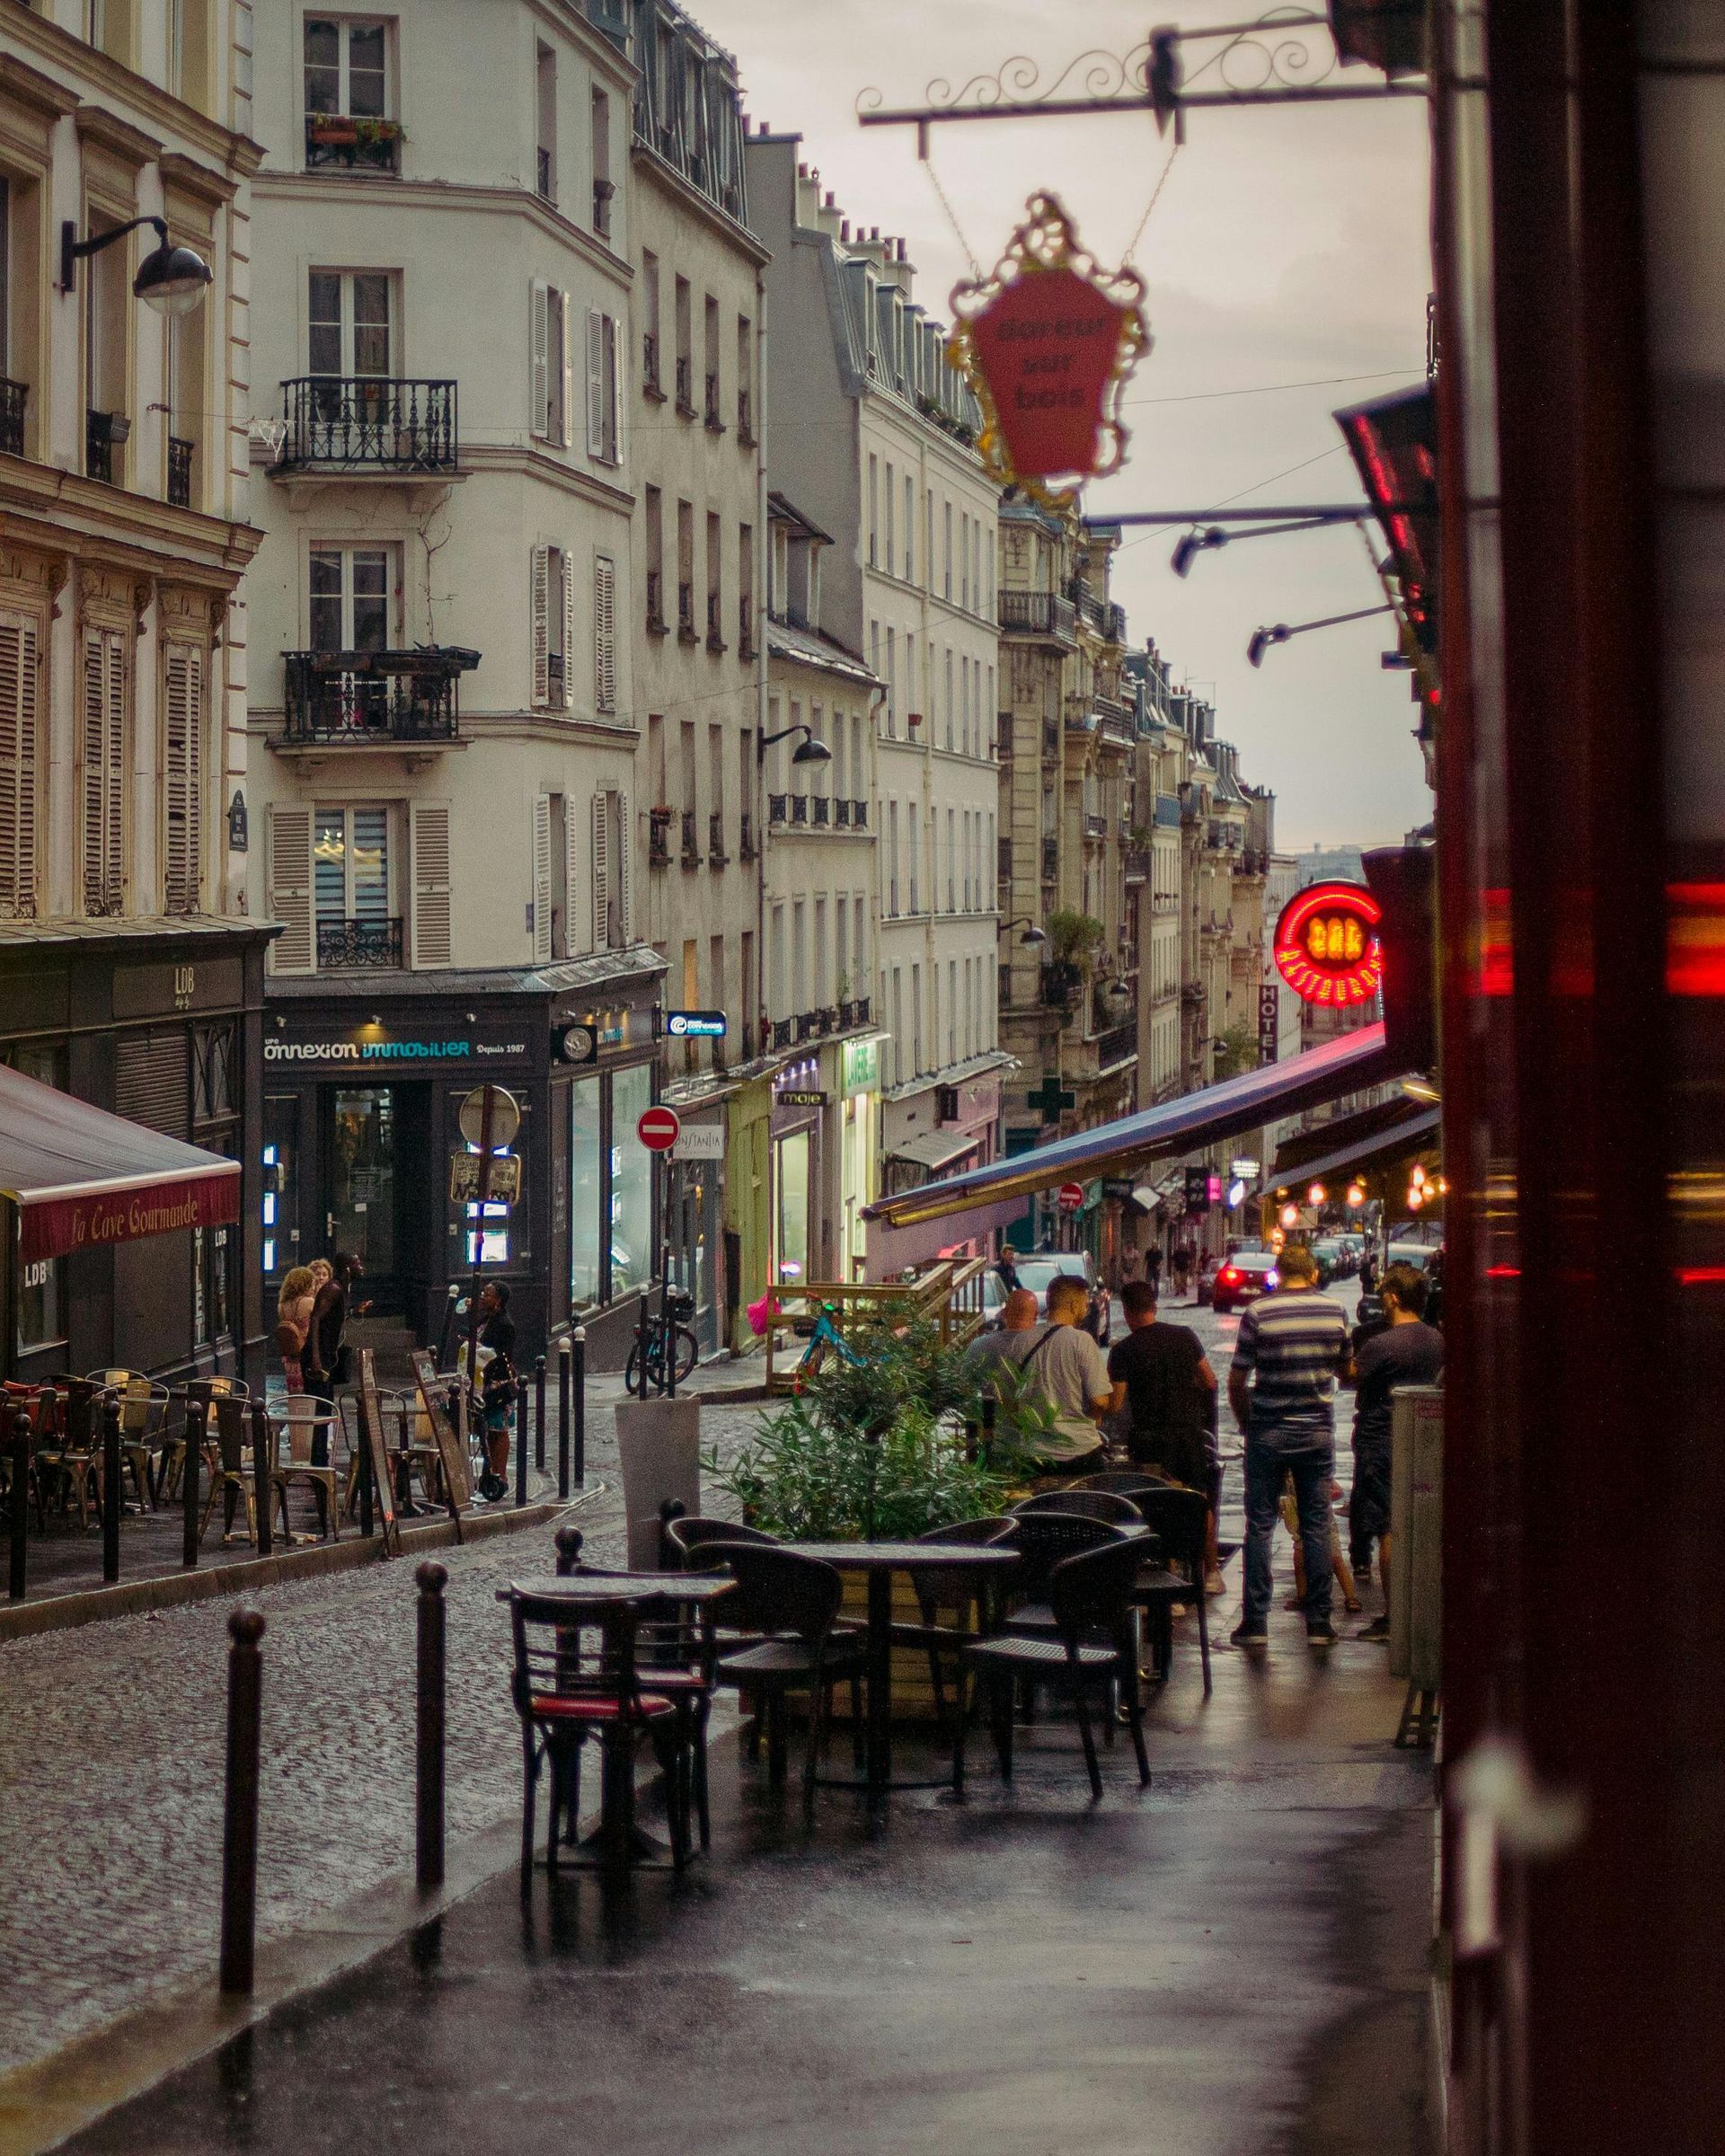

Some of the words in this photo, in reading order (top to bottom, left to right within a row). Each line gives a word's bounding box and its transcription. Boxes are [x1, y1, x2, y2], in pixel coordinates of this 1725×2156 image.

[175, 967, 194, 994] LDB
[1261, 987, 1275, 1064] HOTEL
[264, 1043, 358, 1060] onnexion
[477, 1044, 504, 1055] Depuis
[506, 1044, 525, 1054] 1987
[783, 1093, 821, 1106] maje
[675, 1132, 720, 1148] ONSTANTIA
[91, 1205, 124, 1240] Cave
[129, 1190, 199, 1233] Gourmande
[215, 1230, 226, 1247] LDB
[25, 1261, 47, 1287] LDB
